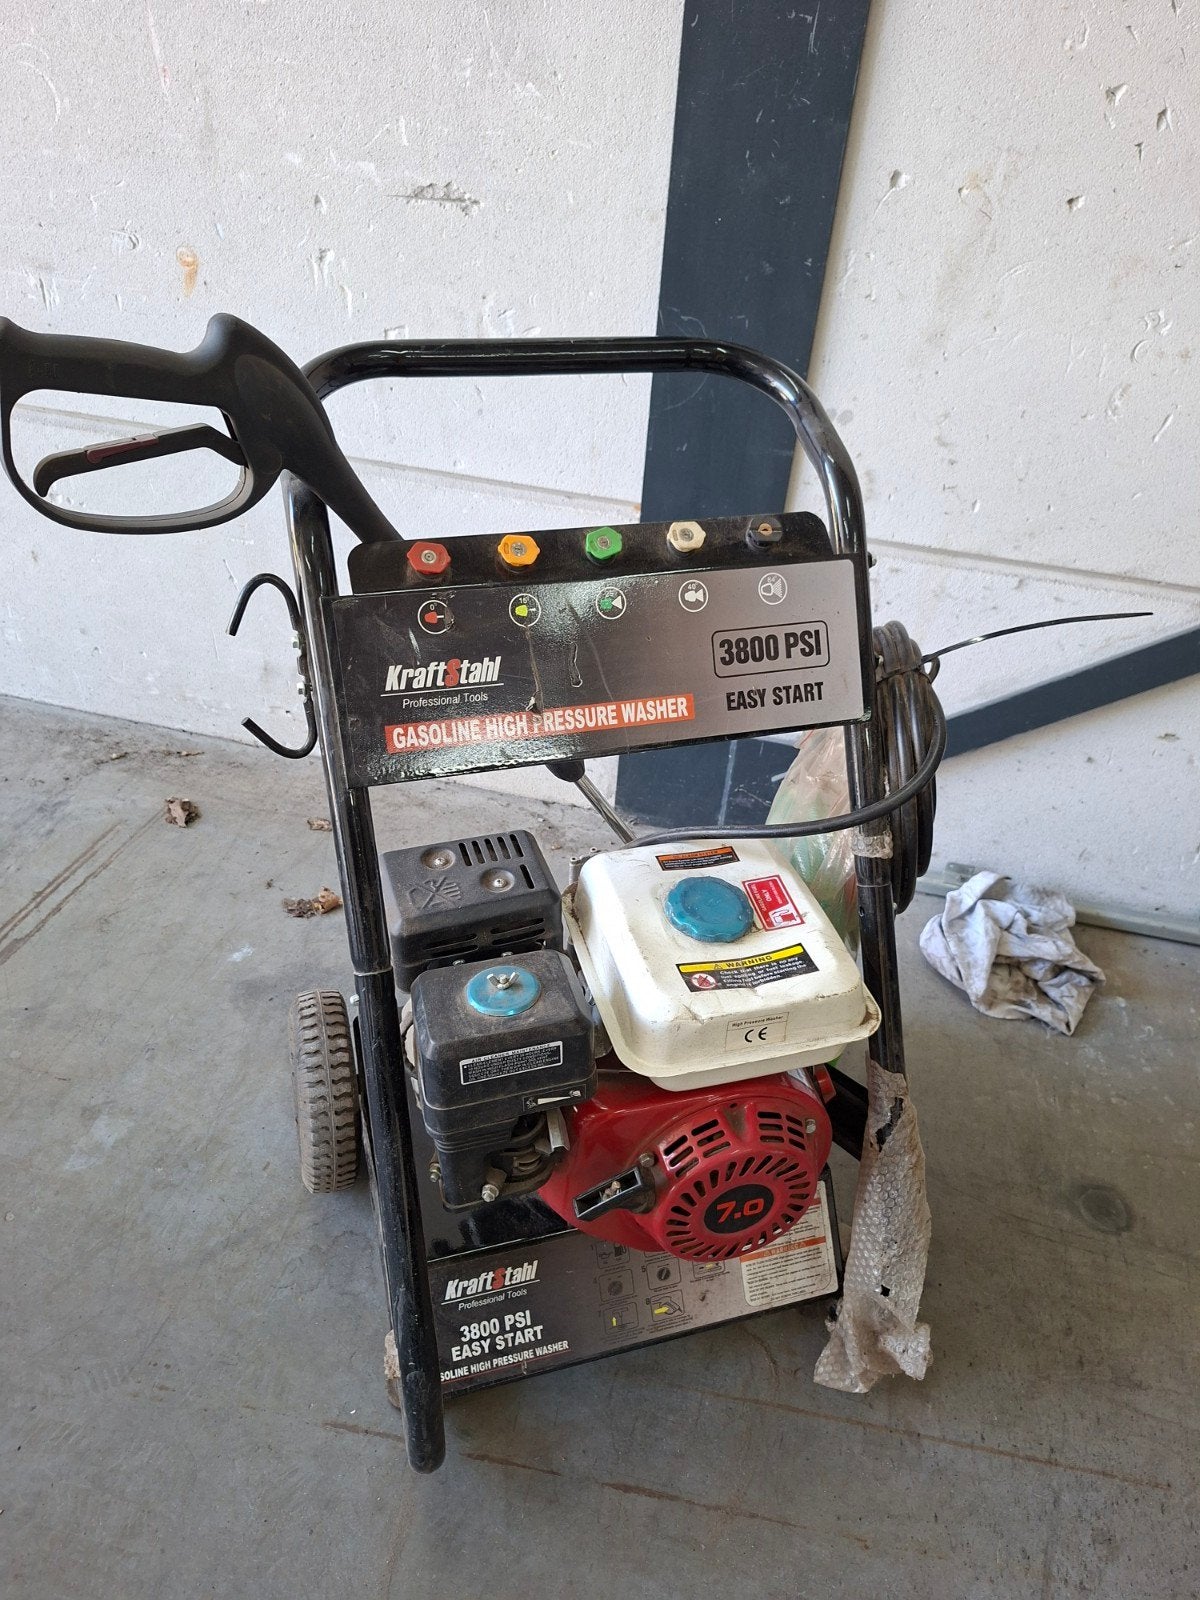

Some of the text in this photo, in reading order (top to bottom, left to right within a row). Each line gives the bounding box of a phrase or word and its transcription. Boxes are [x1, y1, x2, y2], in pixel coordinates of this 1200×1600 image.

[719, 629, 822, 666] 3800 PSI
[385, 656, 502, 692] KraftStahl
[402, 692, 489, 709] Professional Tools
[726, 682, 824, 711] EASY START
[392, 697, 689, 749] GASOLINE HIGH PRESSURE WASHER
[726, 955, 773, 968] WARNING
[716, 1198, 765, 1224] 7.0
[444, 1260, 539, 1300] KraftStahl
[458, 1288, 528, 1311] Professional Tools
[459, 1309, 532, 1342] 3800 PSI
[451, 1325, 544, 1362] EASY START
[440, 1340, 570, 1382] SOLINE HIGH PRESSURE WASHER
